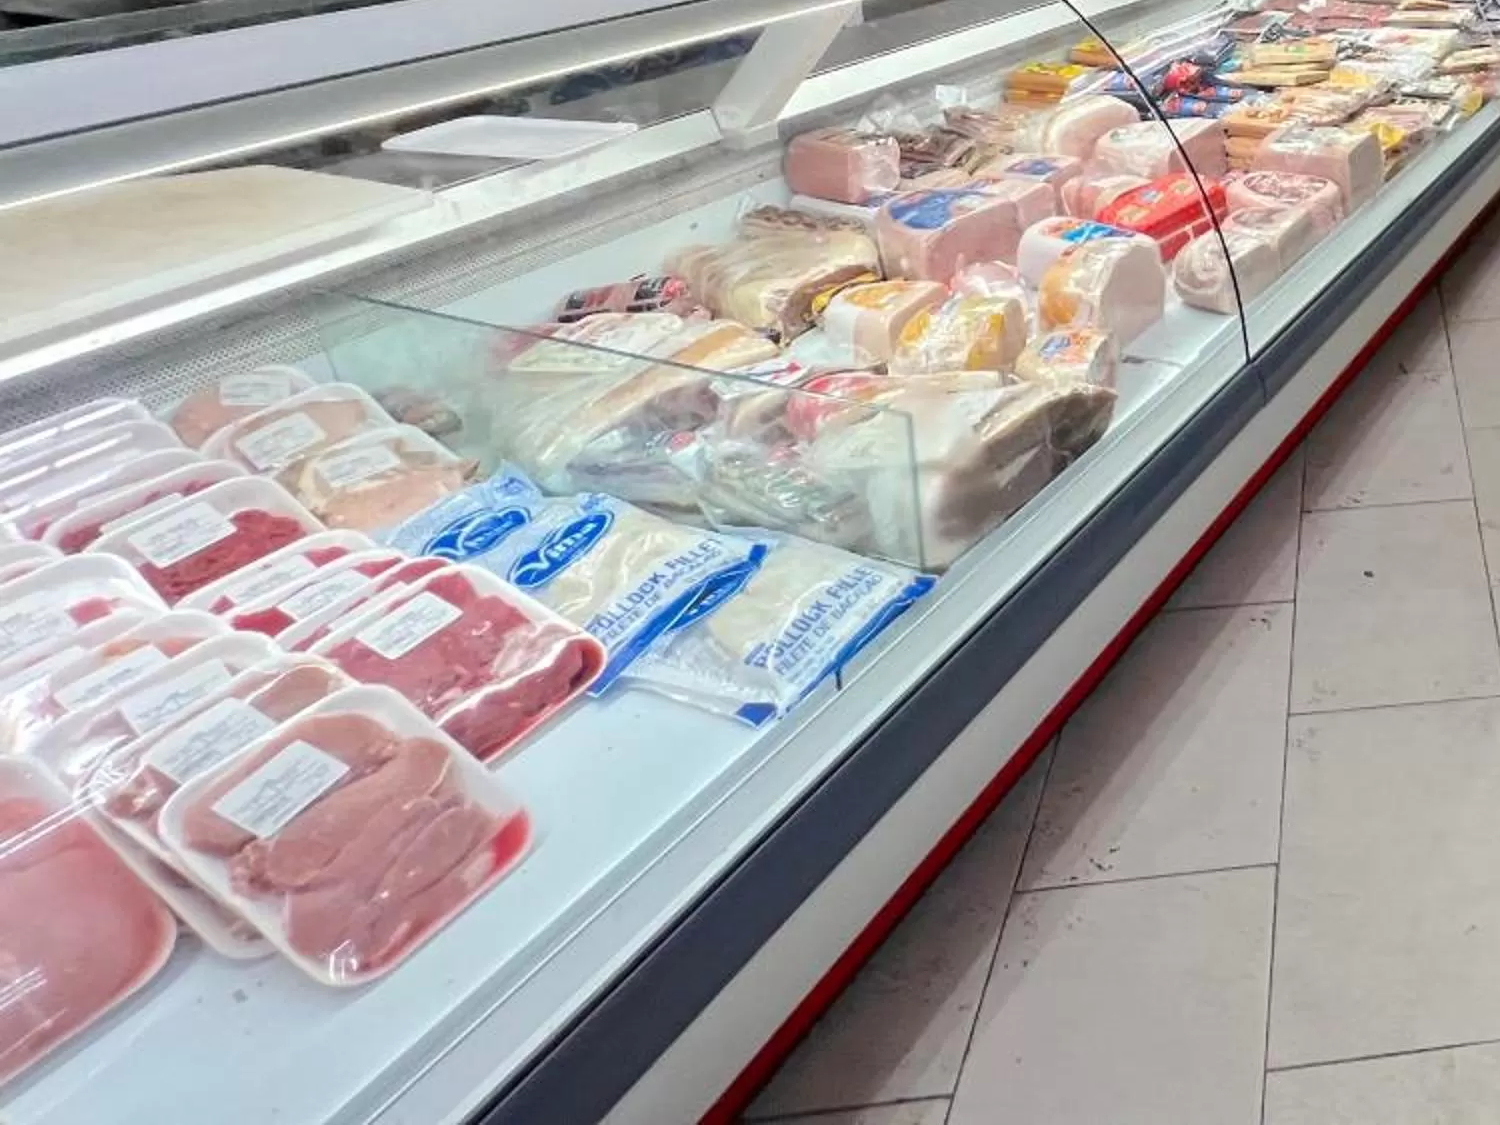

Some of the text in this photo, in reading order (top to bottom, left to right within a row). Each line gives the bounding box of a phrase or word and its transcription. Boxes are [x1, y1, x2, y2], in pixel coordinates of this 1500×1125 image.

[512, 520, 600, 585] Vima
[752, 565, 874, 668] POLLOCK FILLE
